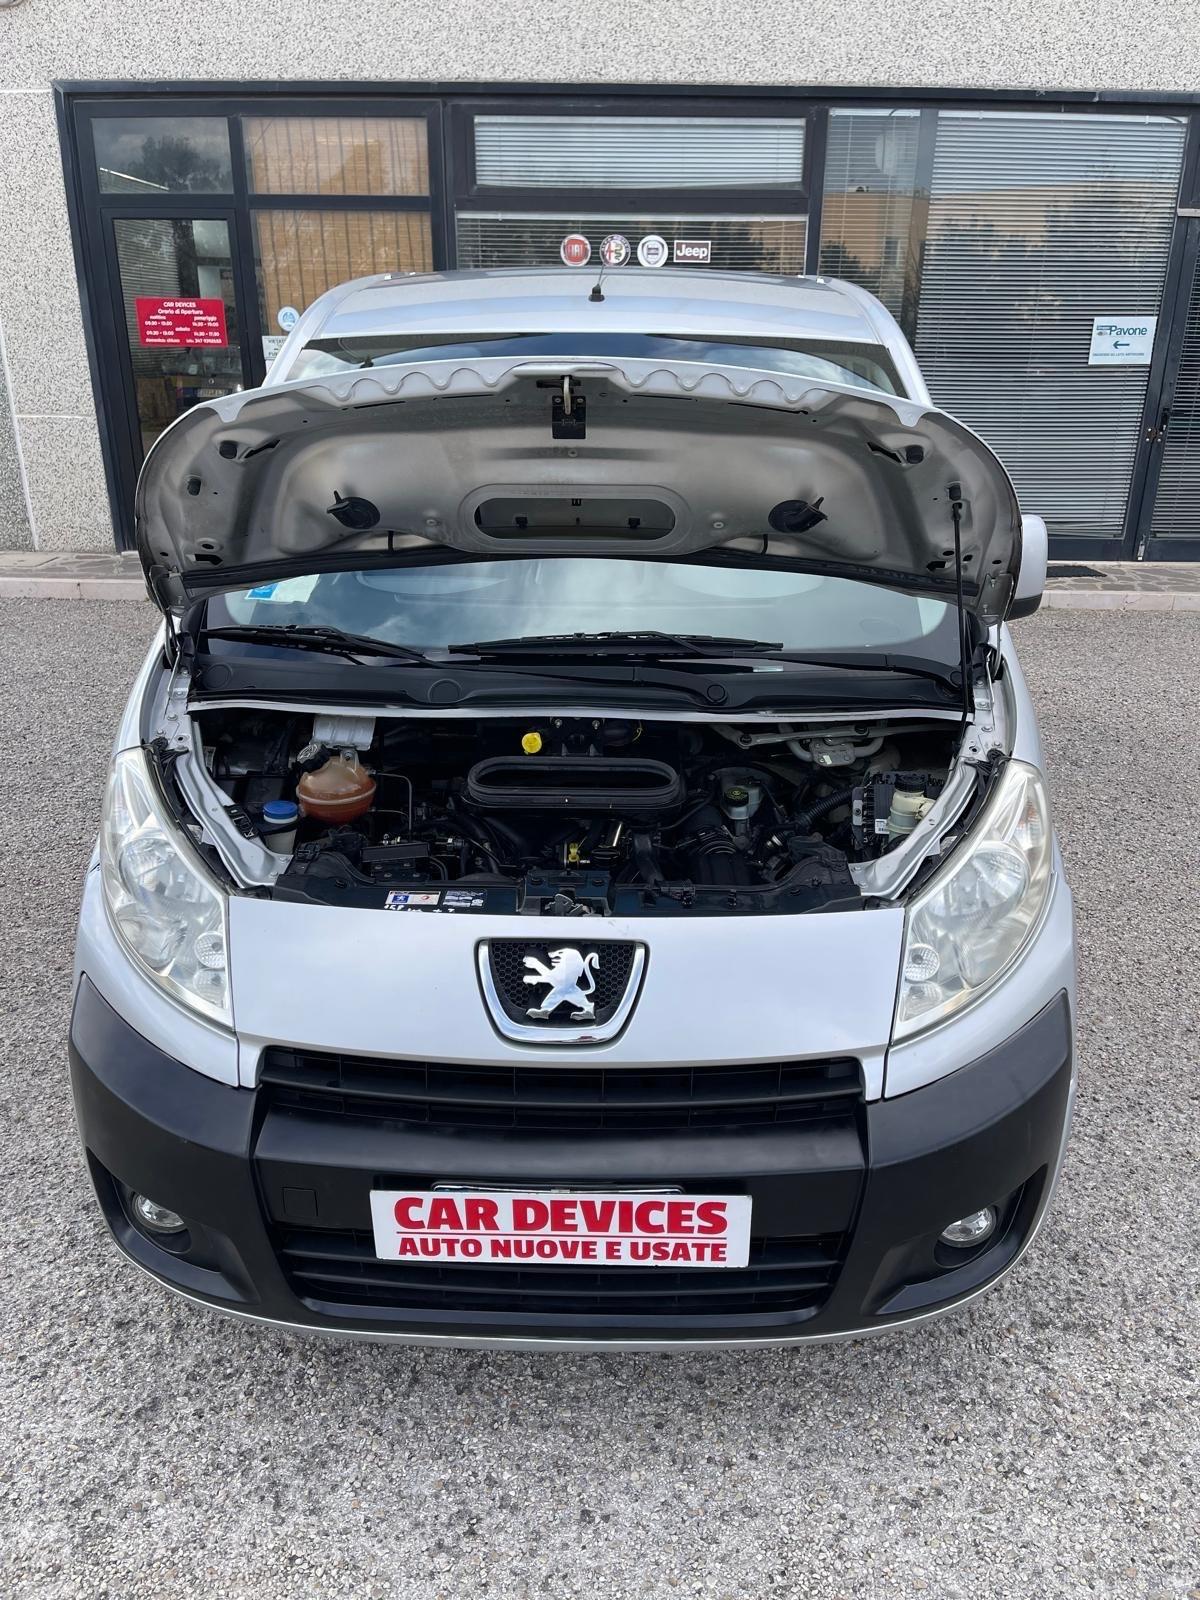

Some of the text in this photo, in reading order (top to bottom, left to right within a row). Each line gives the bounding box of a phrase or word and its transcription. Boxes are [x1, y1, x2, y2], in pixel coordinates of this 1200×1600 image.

[677, 244, 708, 259] Jeep
[1109, 325, 1148, 336] Pavone
[394, 1197, 728, 1234] CAR DEVICES
[399, 1237, 727, 1262] AUTO NUOVE E USATE
